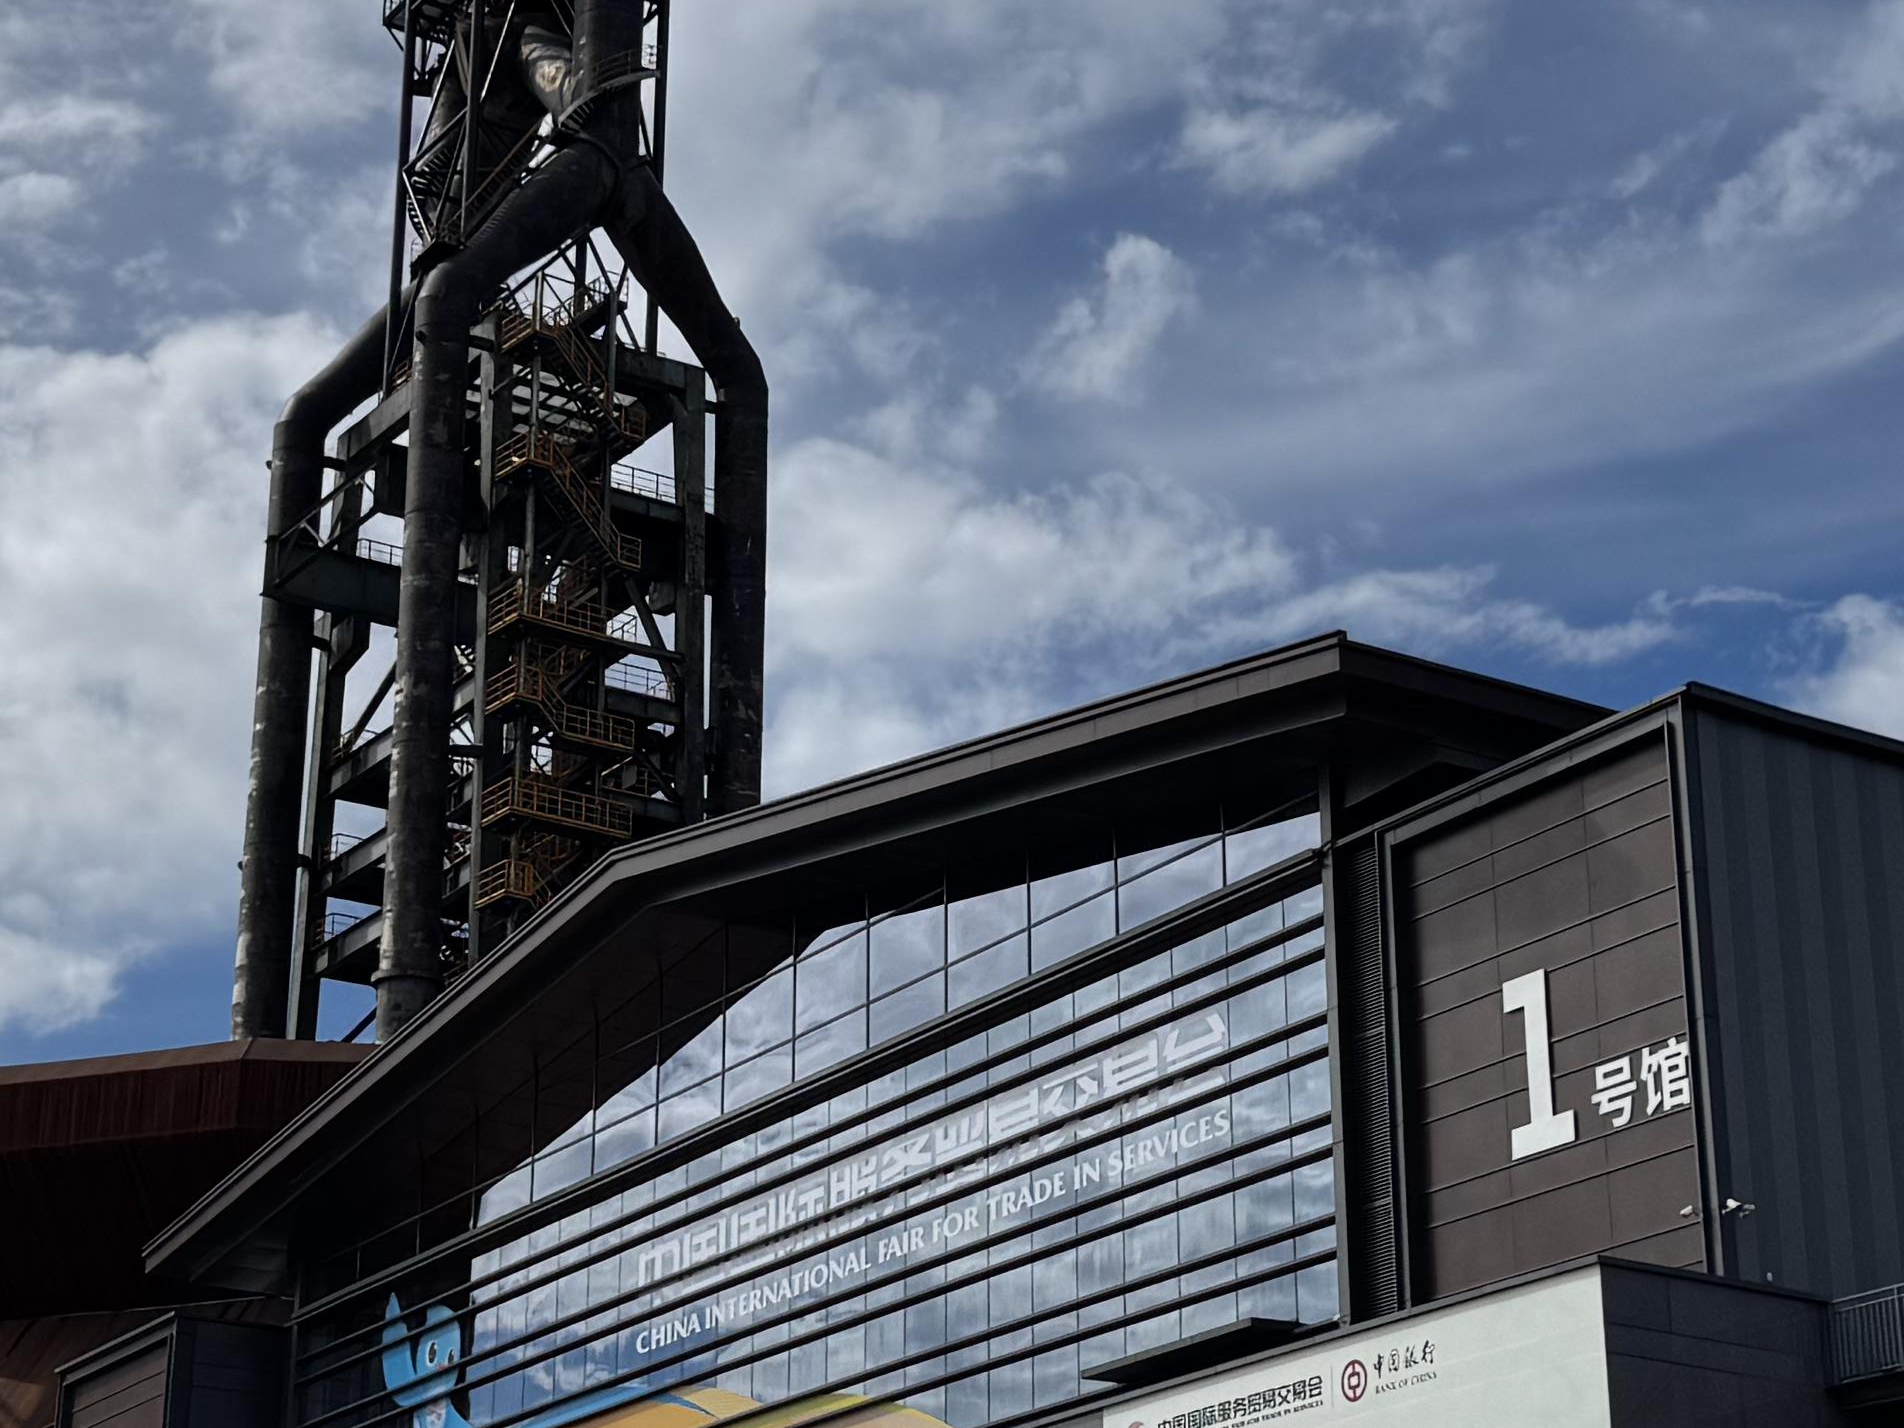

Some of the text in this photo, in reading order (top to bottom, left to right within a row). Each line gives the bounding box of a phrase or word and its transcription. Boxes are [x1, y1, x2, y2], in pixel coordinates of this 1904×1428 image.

[637, 1108, 1232, 1355] CHINA INTERNATIONAL FAIR FOR TRADE IN SERVICES
